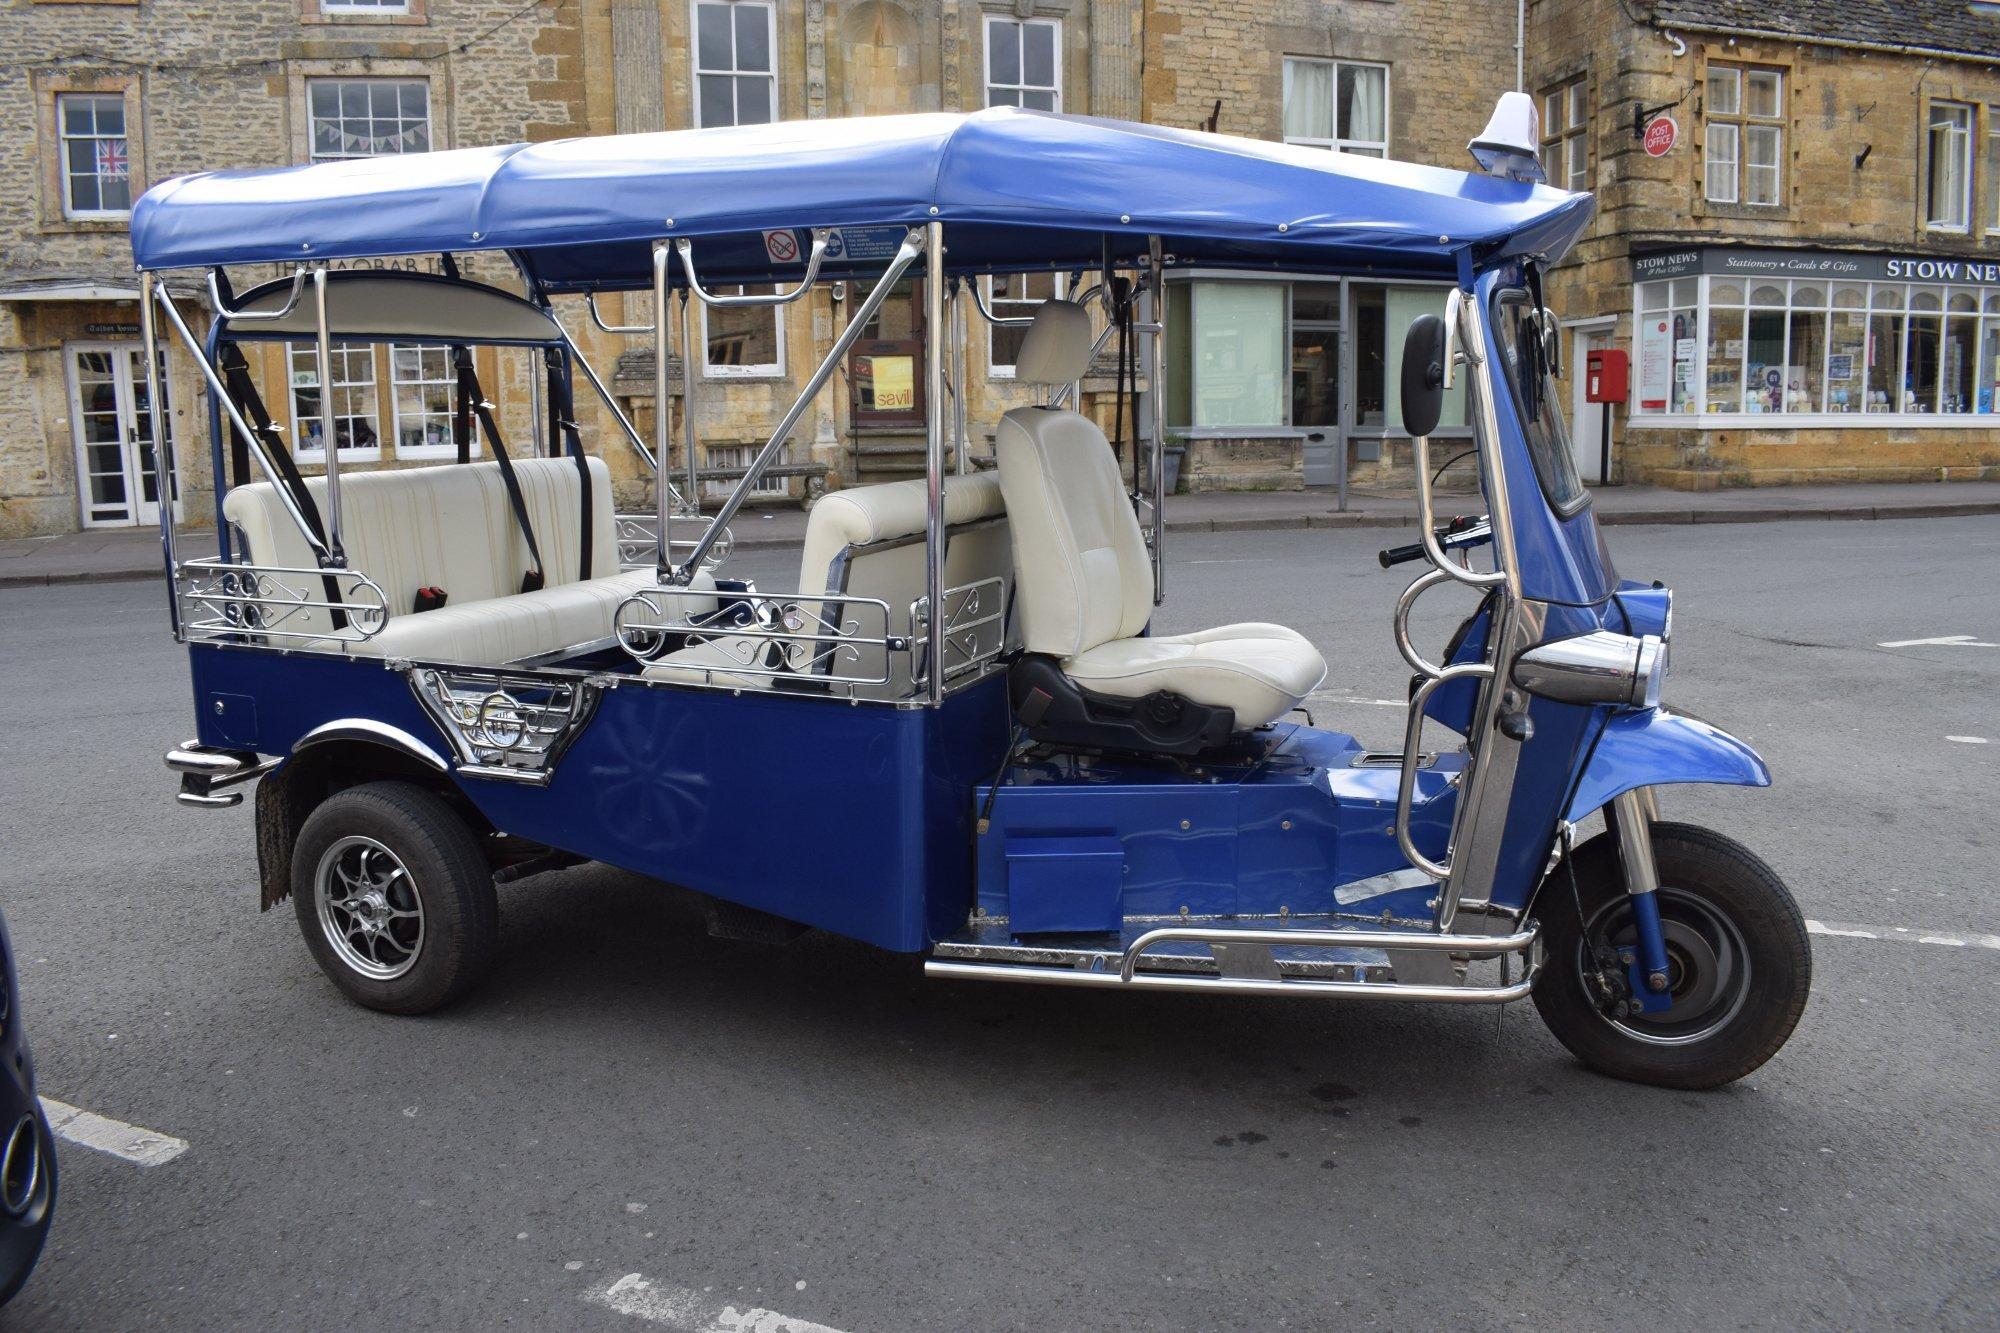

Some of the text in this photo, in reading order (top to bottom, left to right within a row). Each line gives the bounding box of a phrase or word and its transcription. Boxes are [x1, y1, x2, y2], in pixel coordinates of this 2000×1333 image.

[1652, 125, 1669, 138] POST
[1648, 134, 1670, 148] OFFICE
[1636, 252, 1697, 270] STOW NEWS
[1726, 257, 1858, 272] Stationery Cards & Gifts
[1667, 265, 1686, 273] Office
[1887, 260, 2000, 281] STOW NE
